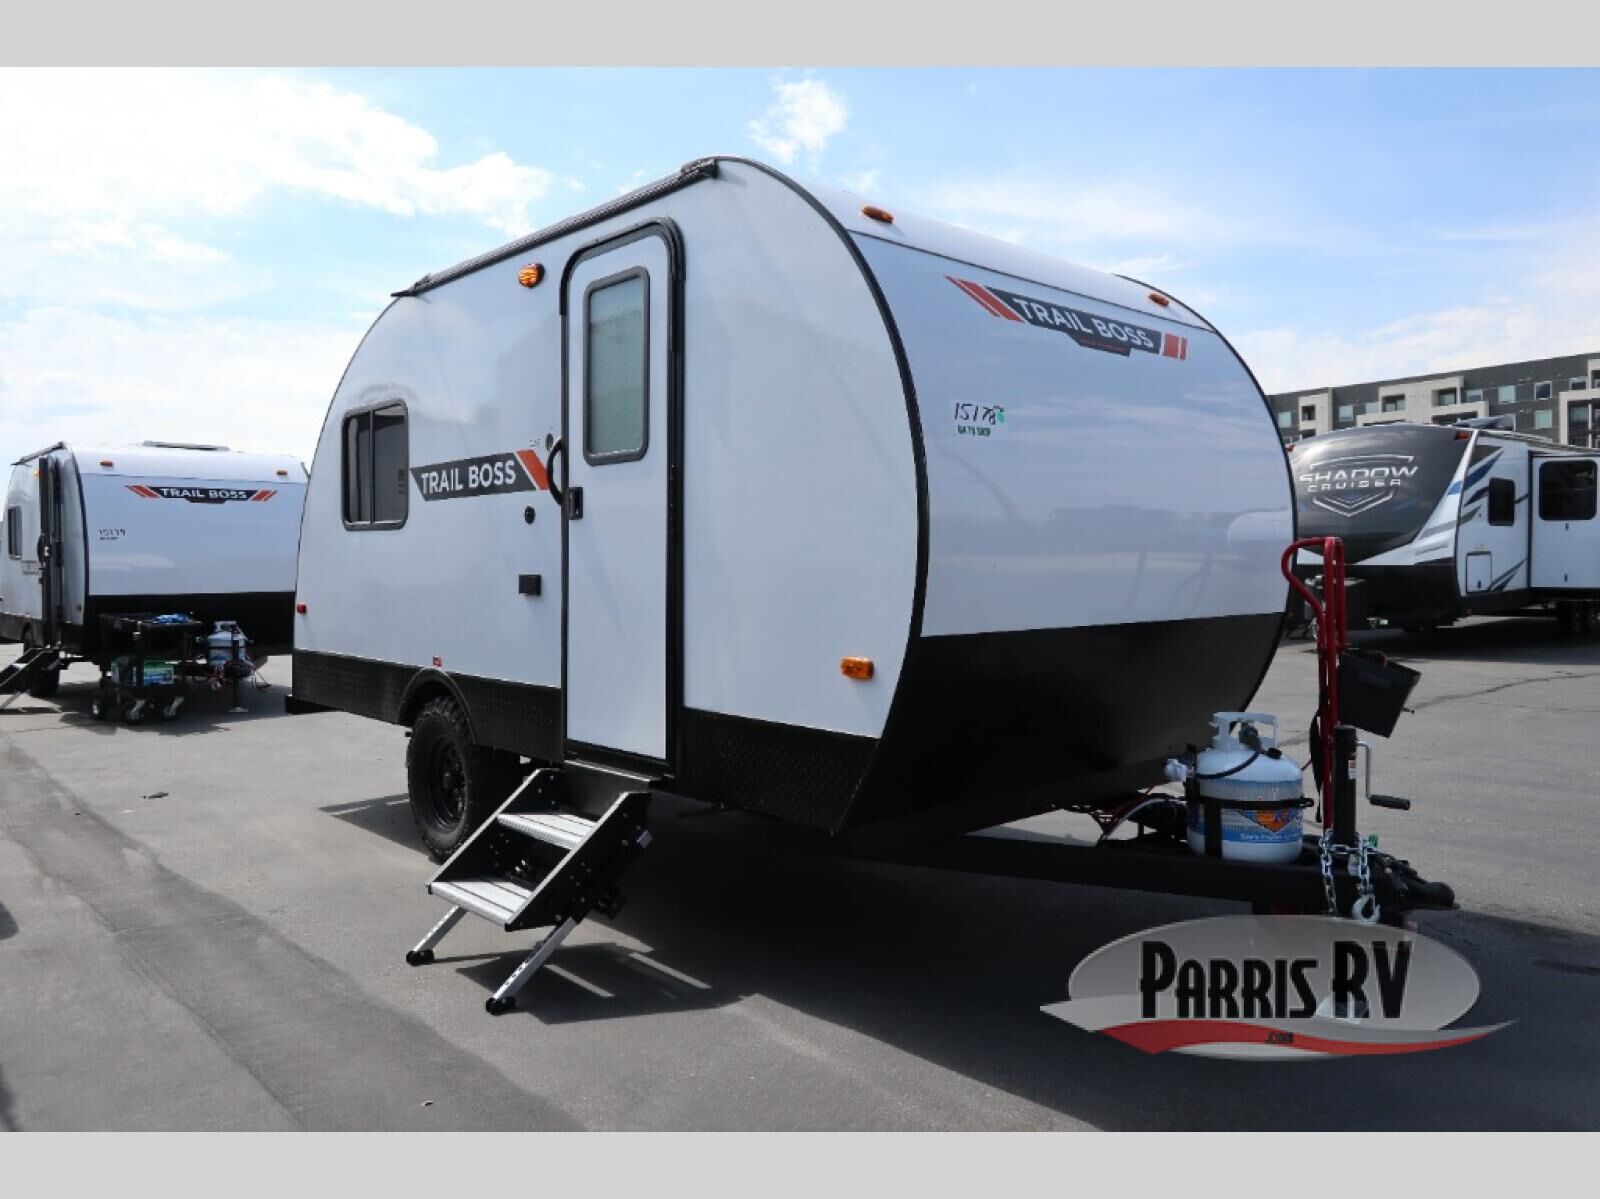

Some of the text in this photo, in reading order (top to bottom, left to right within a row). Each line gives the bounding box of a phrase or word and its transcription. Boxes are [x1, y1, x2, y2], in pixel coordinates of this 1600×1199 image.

[1012, 297, 1094, 334] TRAIL
[1092, 318, 1154, 349] BOSS
[421, 459, 516, 495] TRAIL BOSS
[1299, 465, 1419, 483] SHADOW
[159, 487, 248, 500] TRAIL BOSS
[1307, 478, 1402, 493] CRUISER
